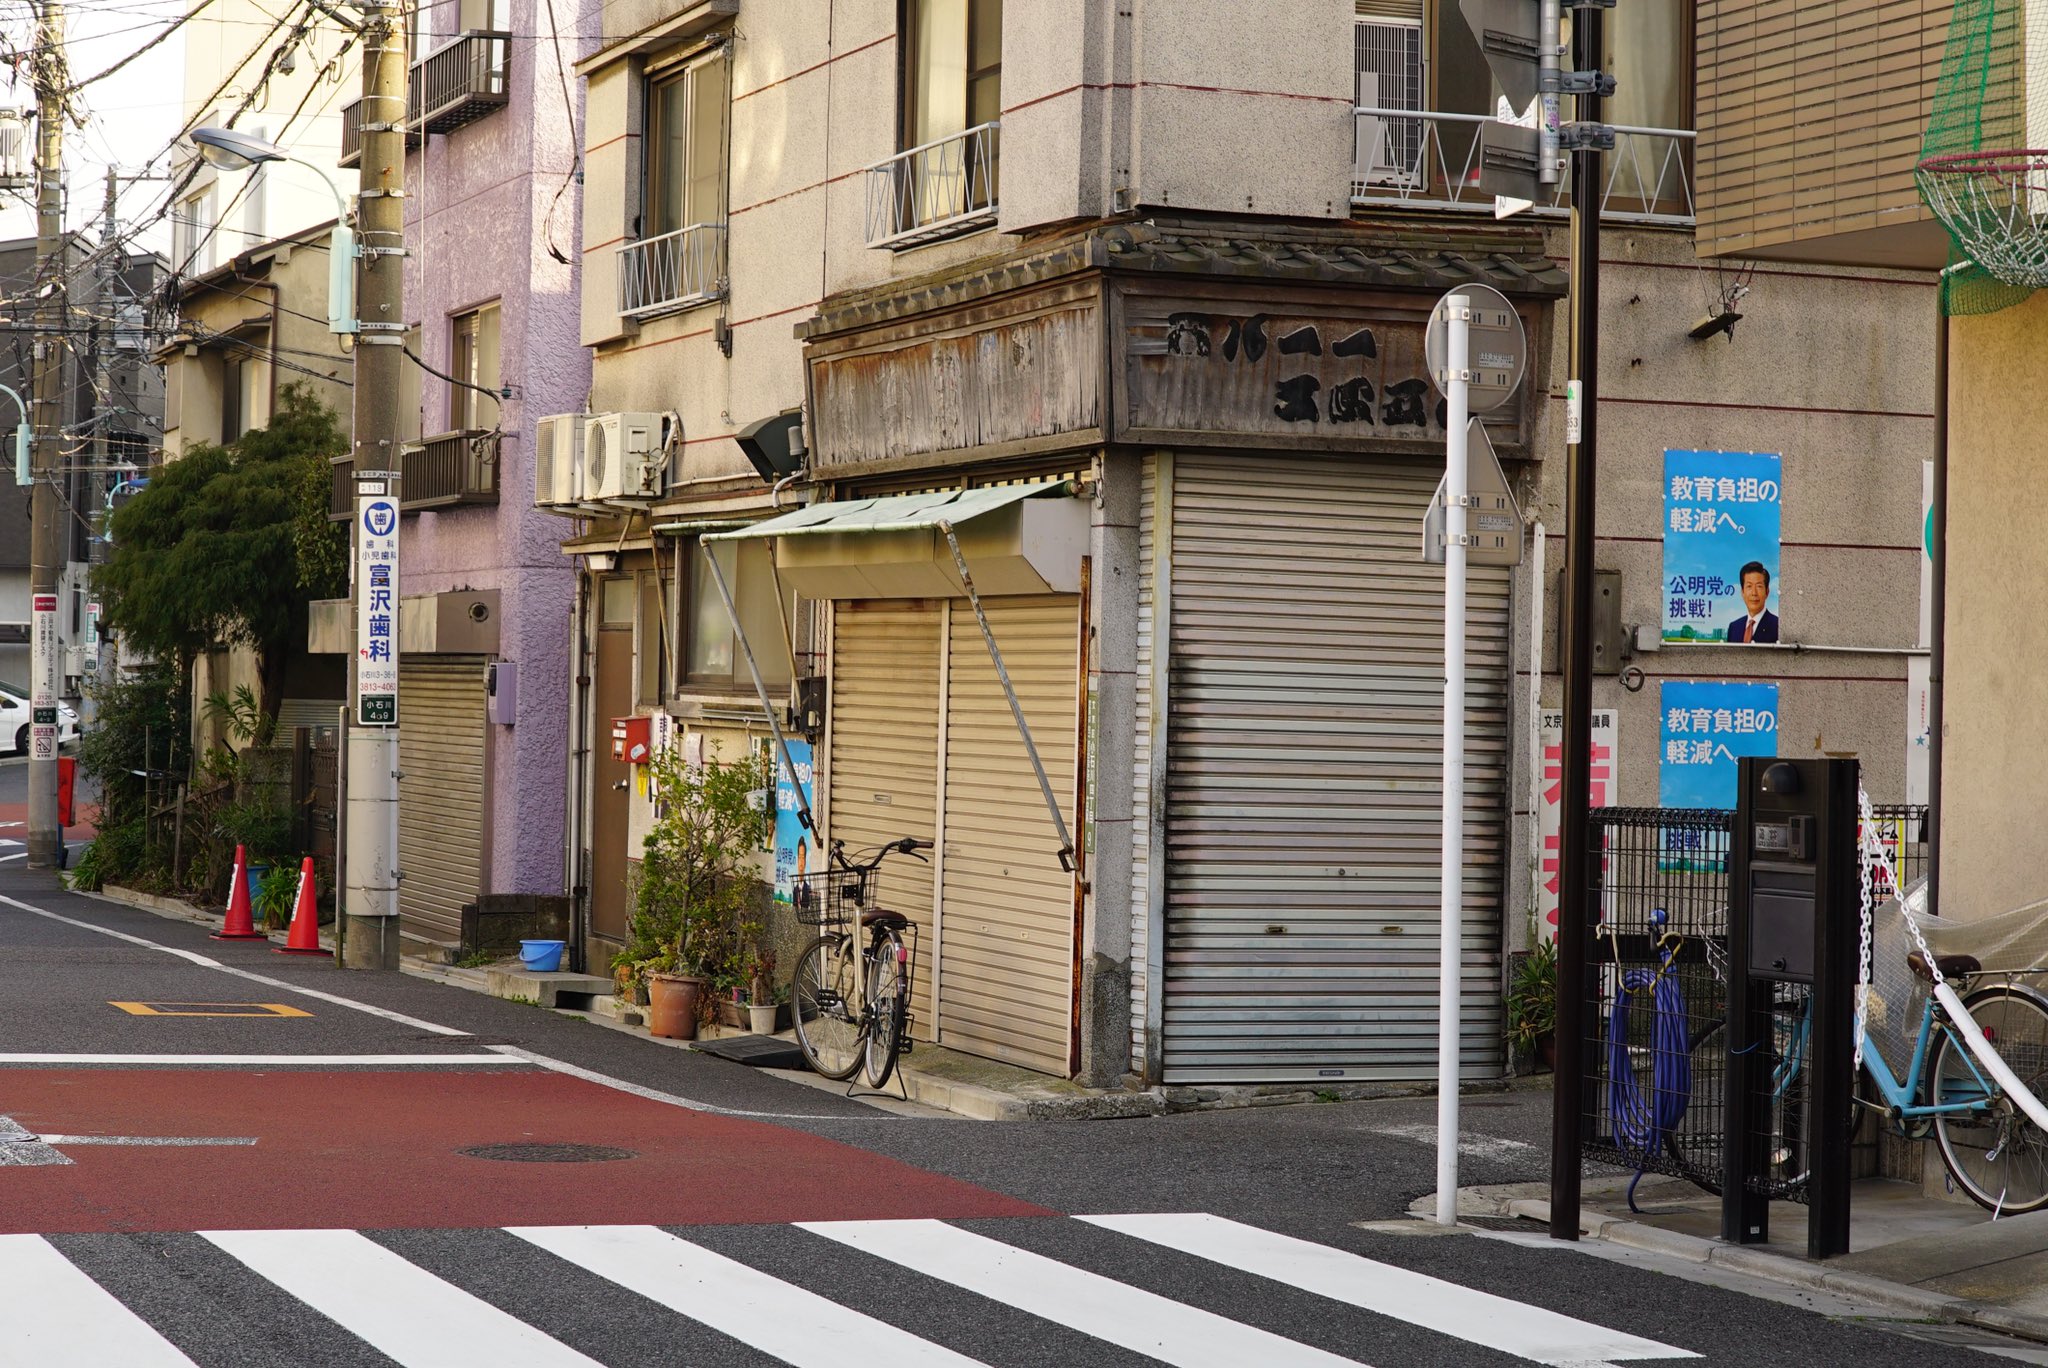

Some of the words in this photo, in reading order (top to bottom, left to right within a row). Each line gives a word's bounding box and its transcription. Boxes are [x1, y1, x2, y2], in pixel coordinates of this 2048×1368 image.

[1671, 476, 1778, 503] 教育負担の
[1670, 507, 1745, 535] 軽減へ。
[362, 551, 397, 560] 小児歯科
[1670, 575, 1735, 596] 公明党の
[369, 564, 391, 662] 富沢歯科
[1669, 598, 1712, 618] 挑戦!
[366, 701, 392, 709] 小石川
[1544, 714, 1610, 729] 文京議員
[1668, 708, 1775, 733] 教育負担の
